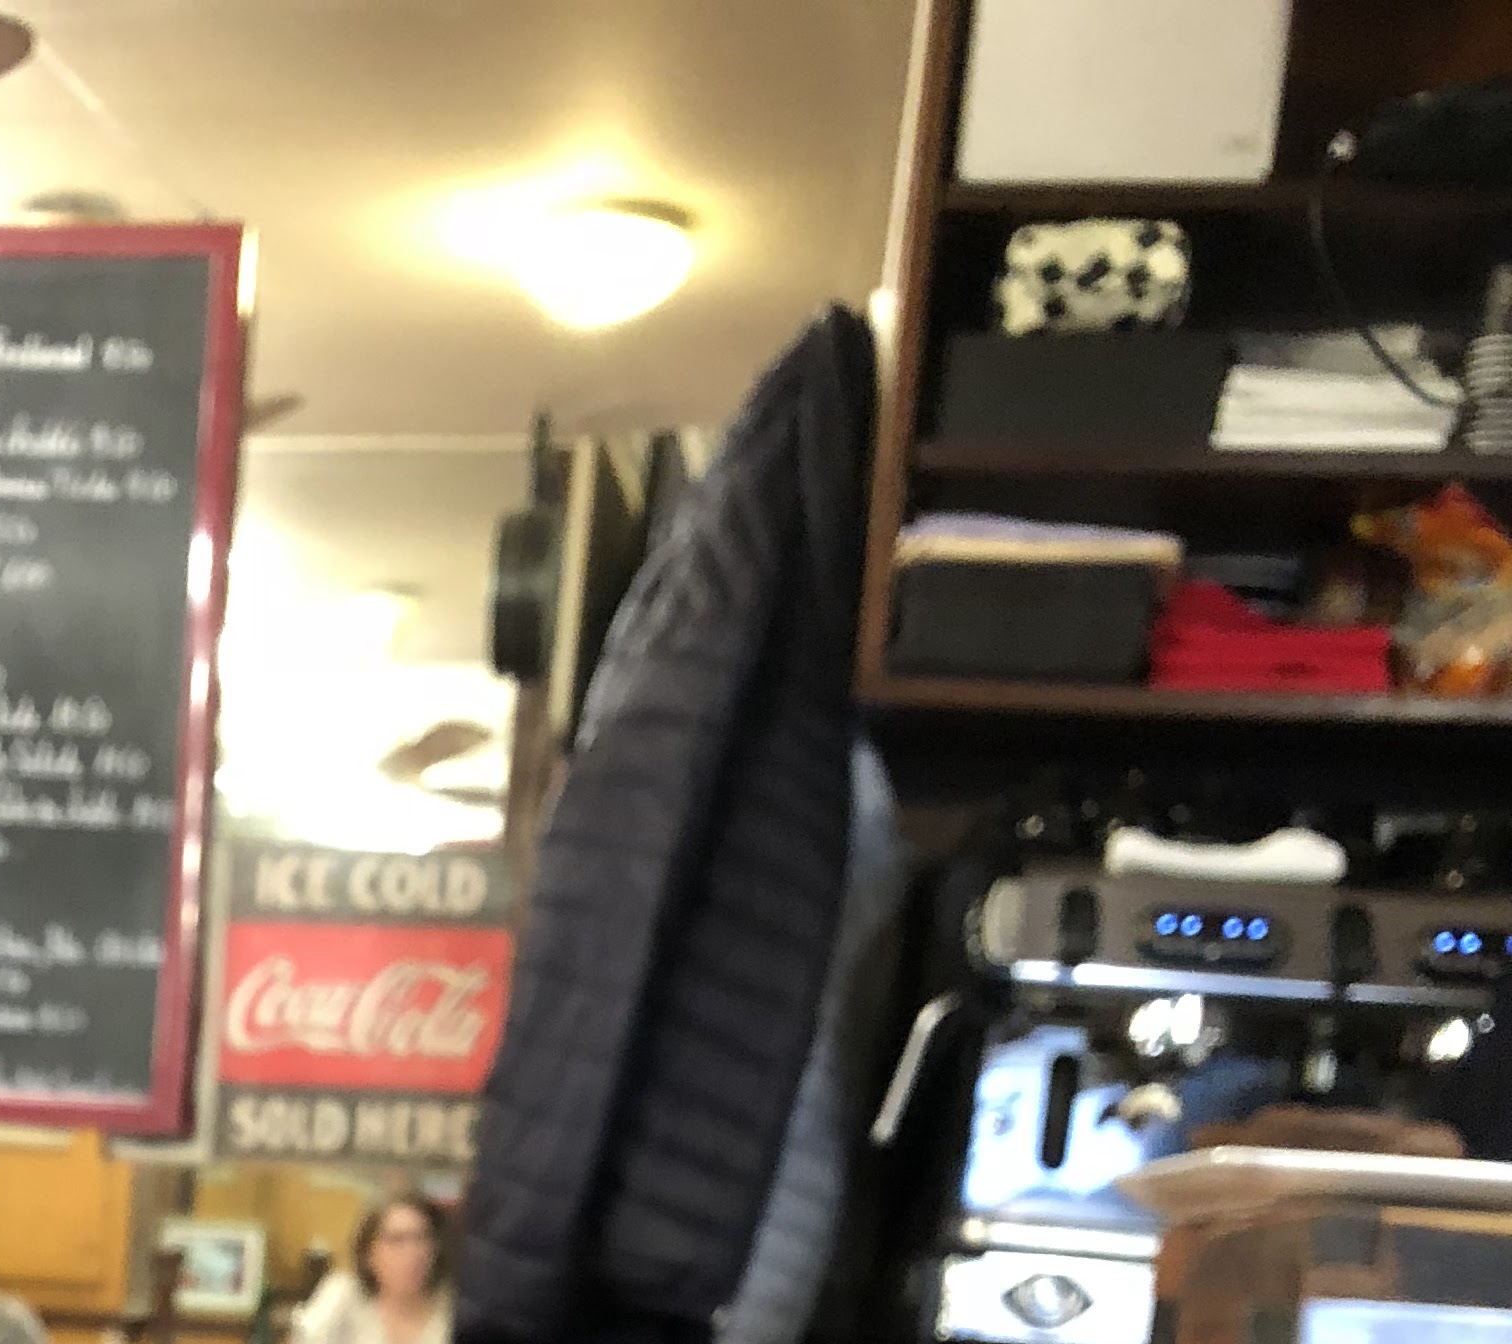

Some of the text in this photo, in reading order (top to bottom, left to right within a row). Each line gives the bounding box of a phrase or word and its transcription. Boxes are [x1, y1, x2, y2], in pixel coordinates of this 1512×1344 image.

[254, 855, 488, 916] ICE COLD
[231, 1097, 350, 1151] SOLD
